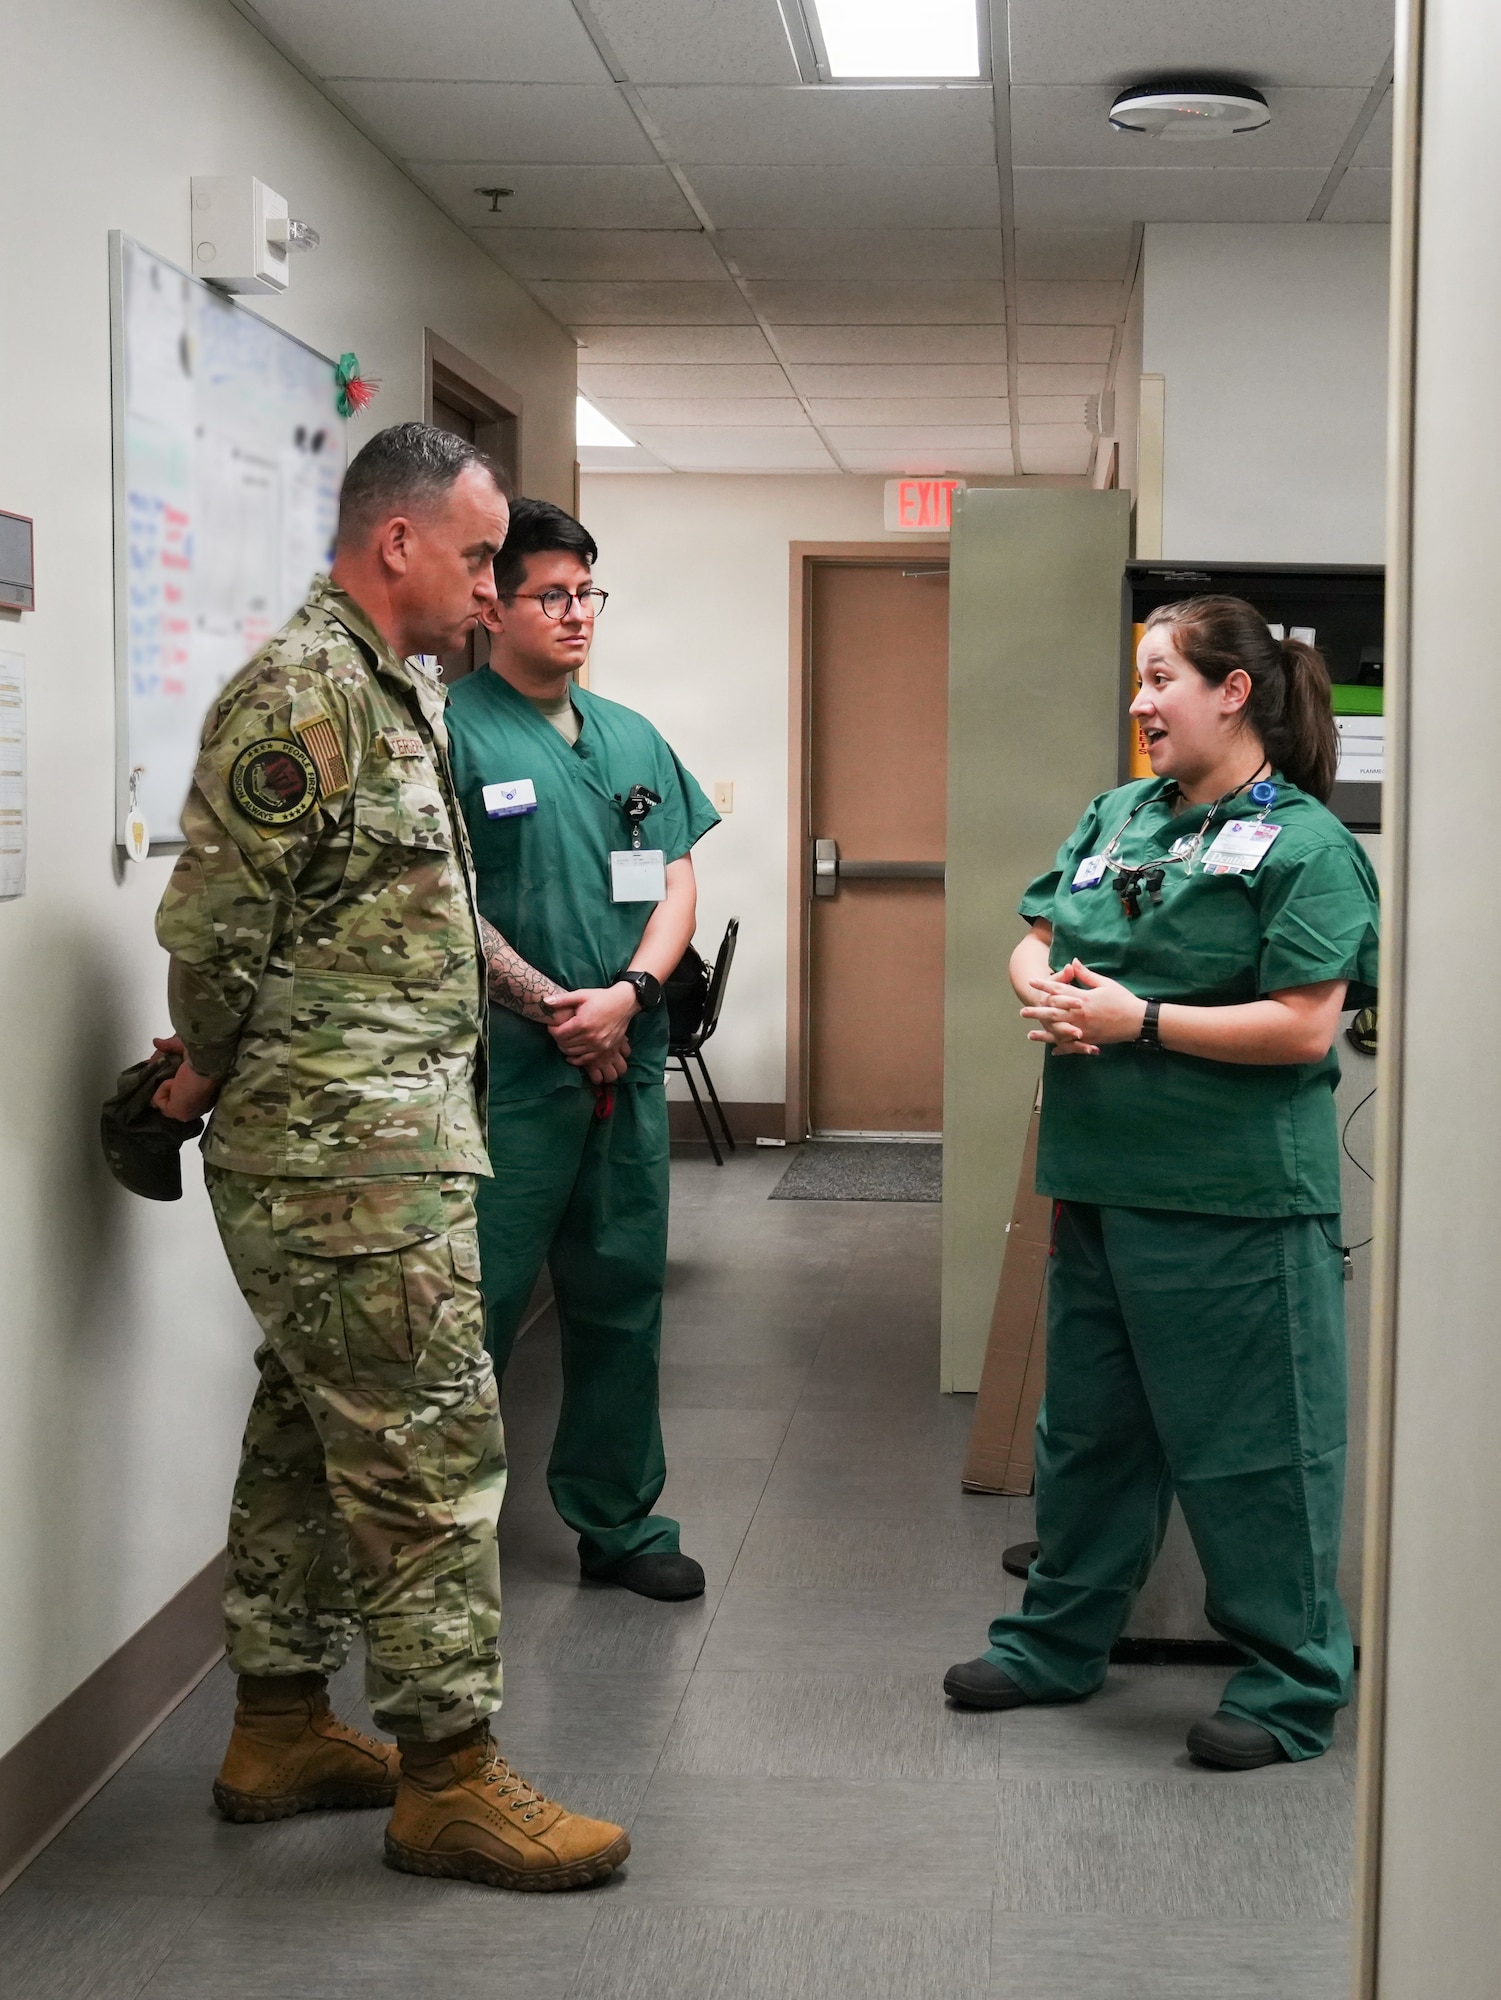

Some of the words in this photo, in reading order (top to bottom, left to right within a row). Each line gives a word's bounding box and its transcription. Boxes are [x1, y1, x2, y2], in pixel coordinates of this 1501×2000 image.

[899, 482, 957, 526] EXIT
[234, 763, 246, 799] MISSION
[243, 801, 274, 821] ALWAYS
[282, 744, 312, 769] PEOPLE
[307, 772, 316, 797] FIRST
